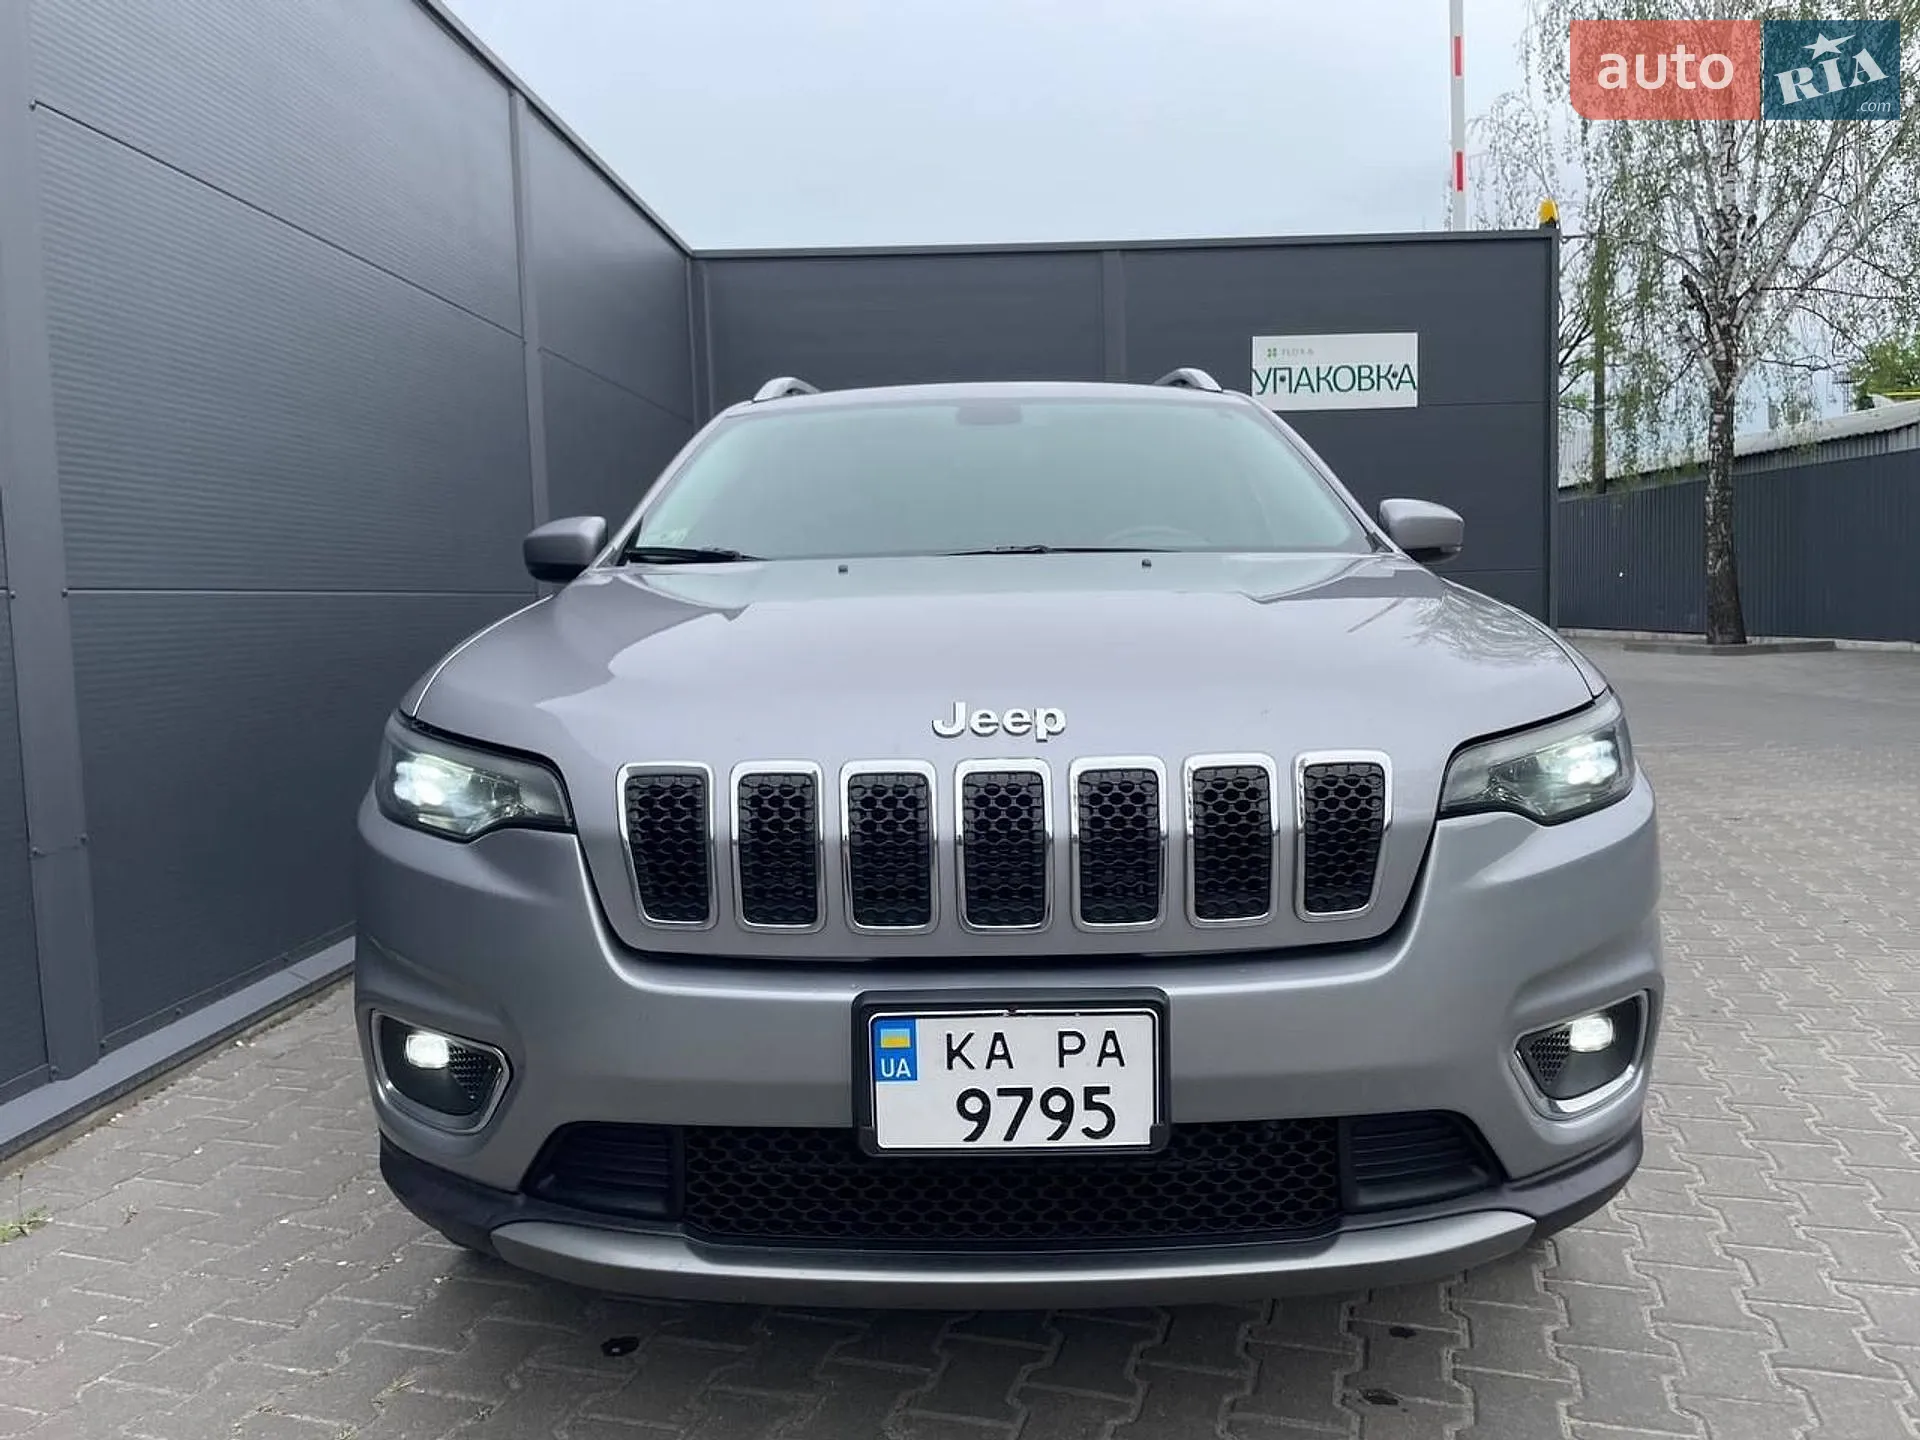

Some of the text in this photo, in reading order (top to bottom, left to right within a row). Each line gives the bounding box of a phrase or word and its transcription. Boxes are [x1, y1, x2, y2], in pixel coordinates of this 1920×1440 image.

[1252, 363, 1417, 395] УПАКОВКА
[932, 701, 1067, 743] Jeep
[880, 1058, 912, 1078] UA
[946, 1030, 1126, 1070] KA PA
[956, 1086, 1116, 1142] 9795
